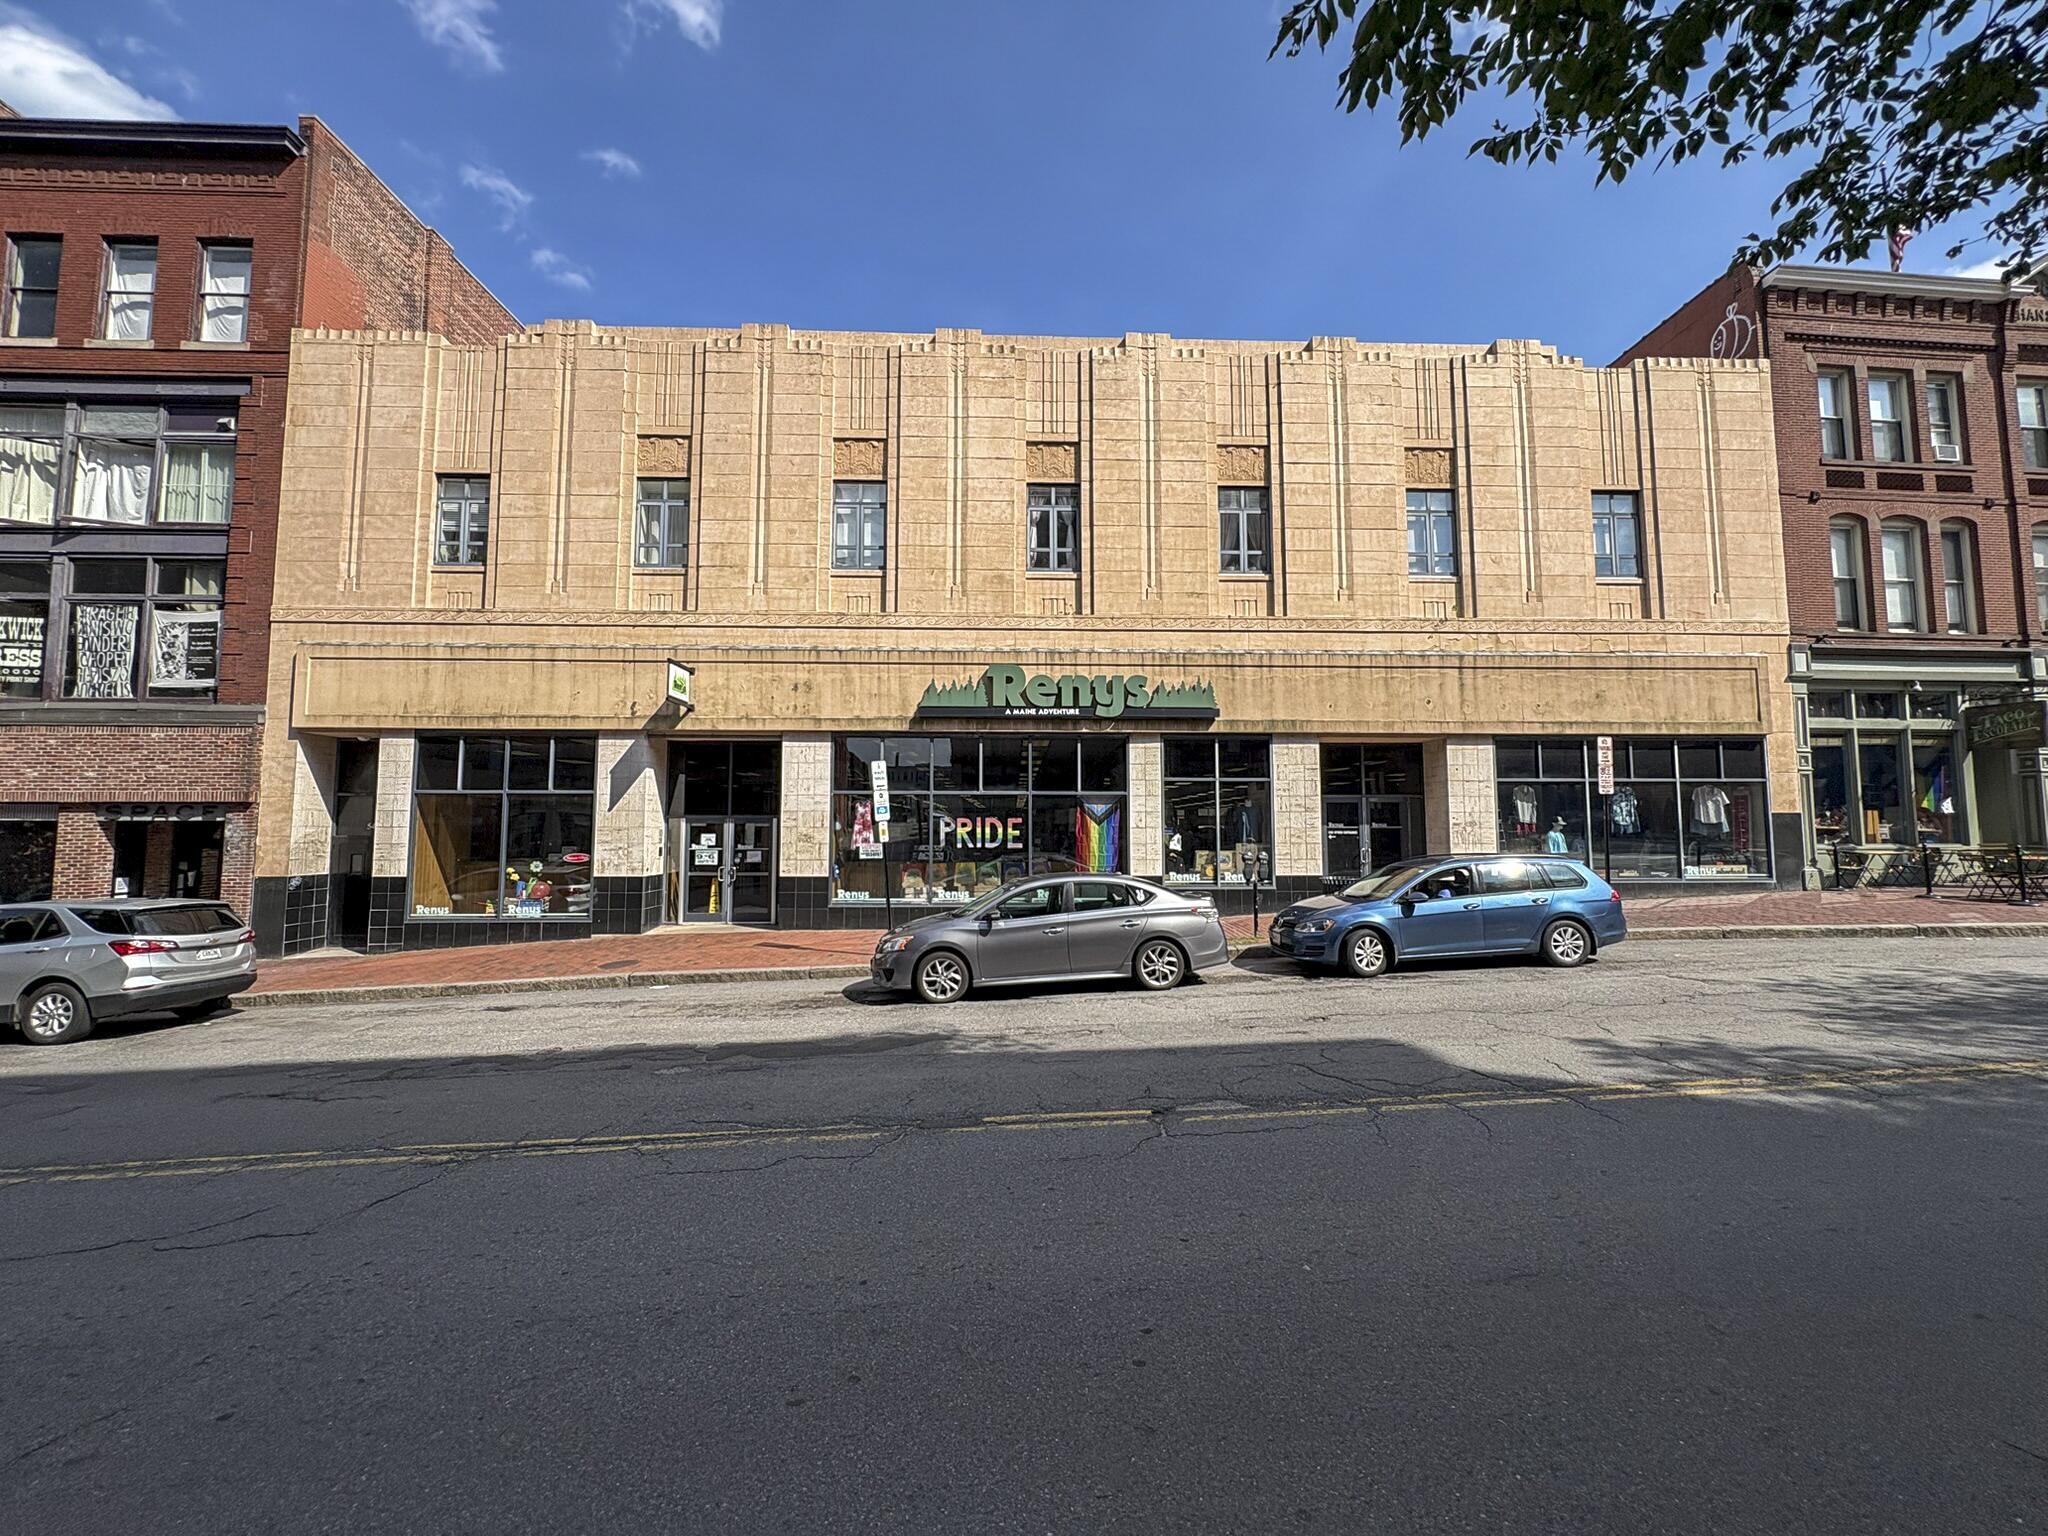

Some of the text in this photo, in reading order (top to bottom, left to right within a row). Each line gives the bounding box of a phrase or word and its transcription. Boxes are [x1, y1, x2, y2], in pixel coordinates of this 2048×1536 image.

[0, 648, 42, 668] ESS
[986, 663, 1151, 718] Renys
[1983, 709, 2025, 727] TACO
[104, 804, 220, 820] SPACE
[939, 816, 1024, 849] PRIDE
[1685, 865, 1717, 875] Renys
[1169, 871, 1200, 881] Renys
[837, 889, 870, 899] Renys
[938, 889, 970, 899] Renys
[416, 905, 450, 915] Renys
[508, 904, 541, 915] Renys
